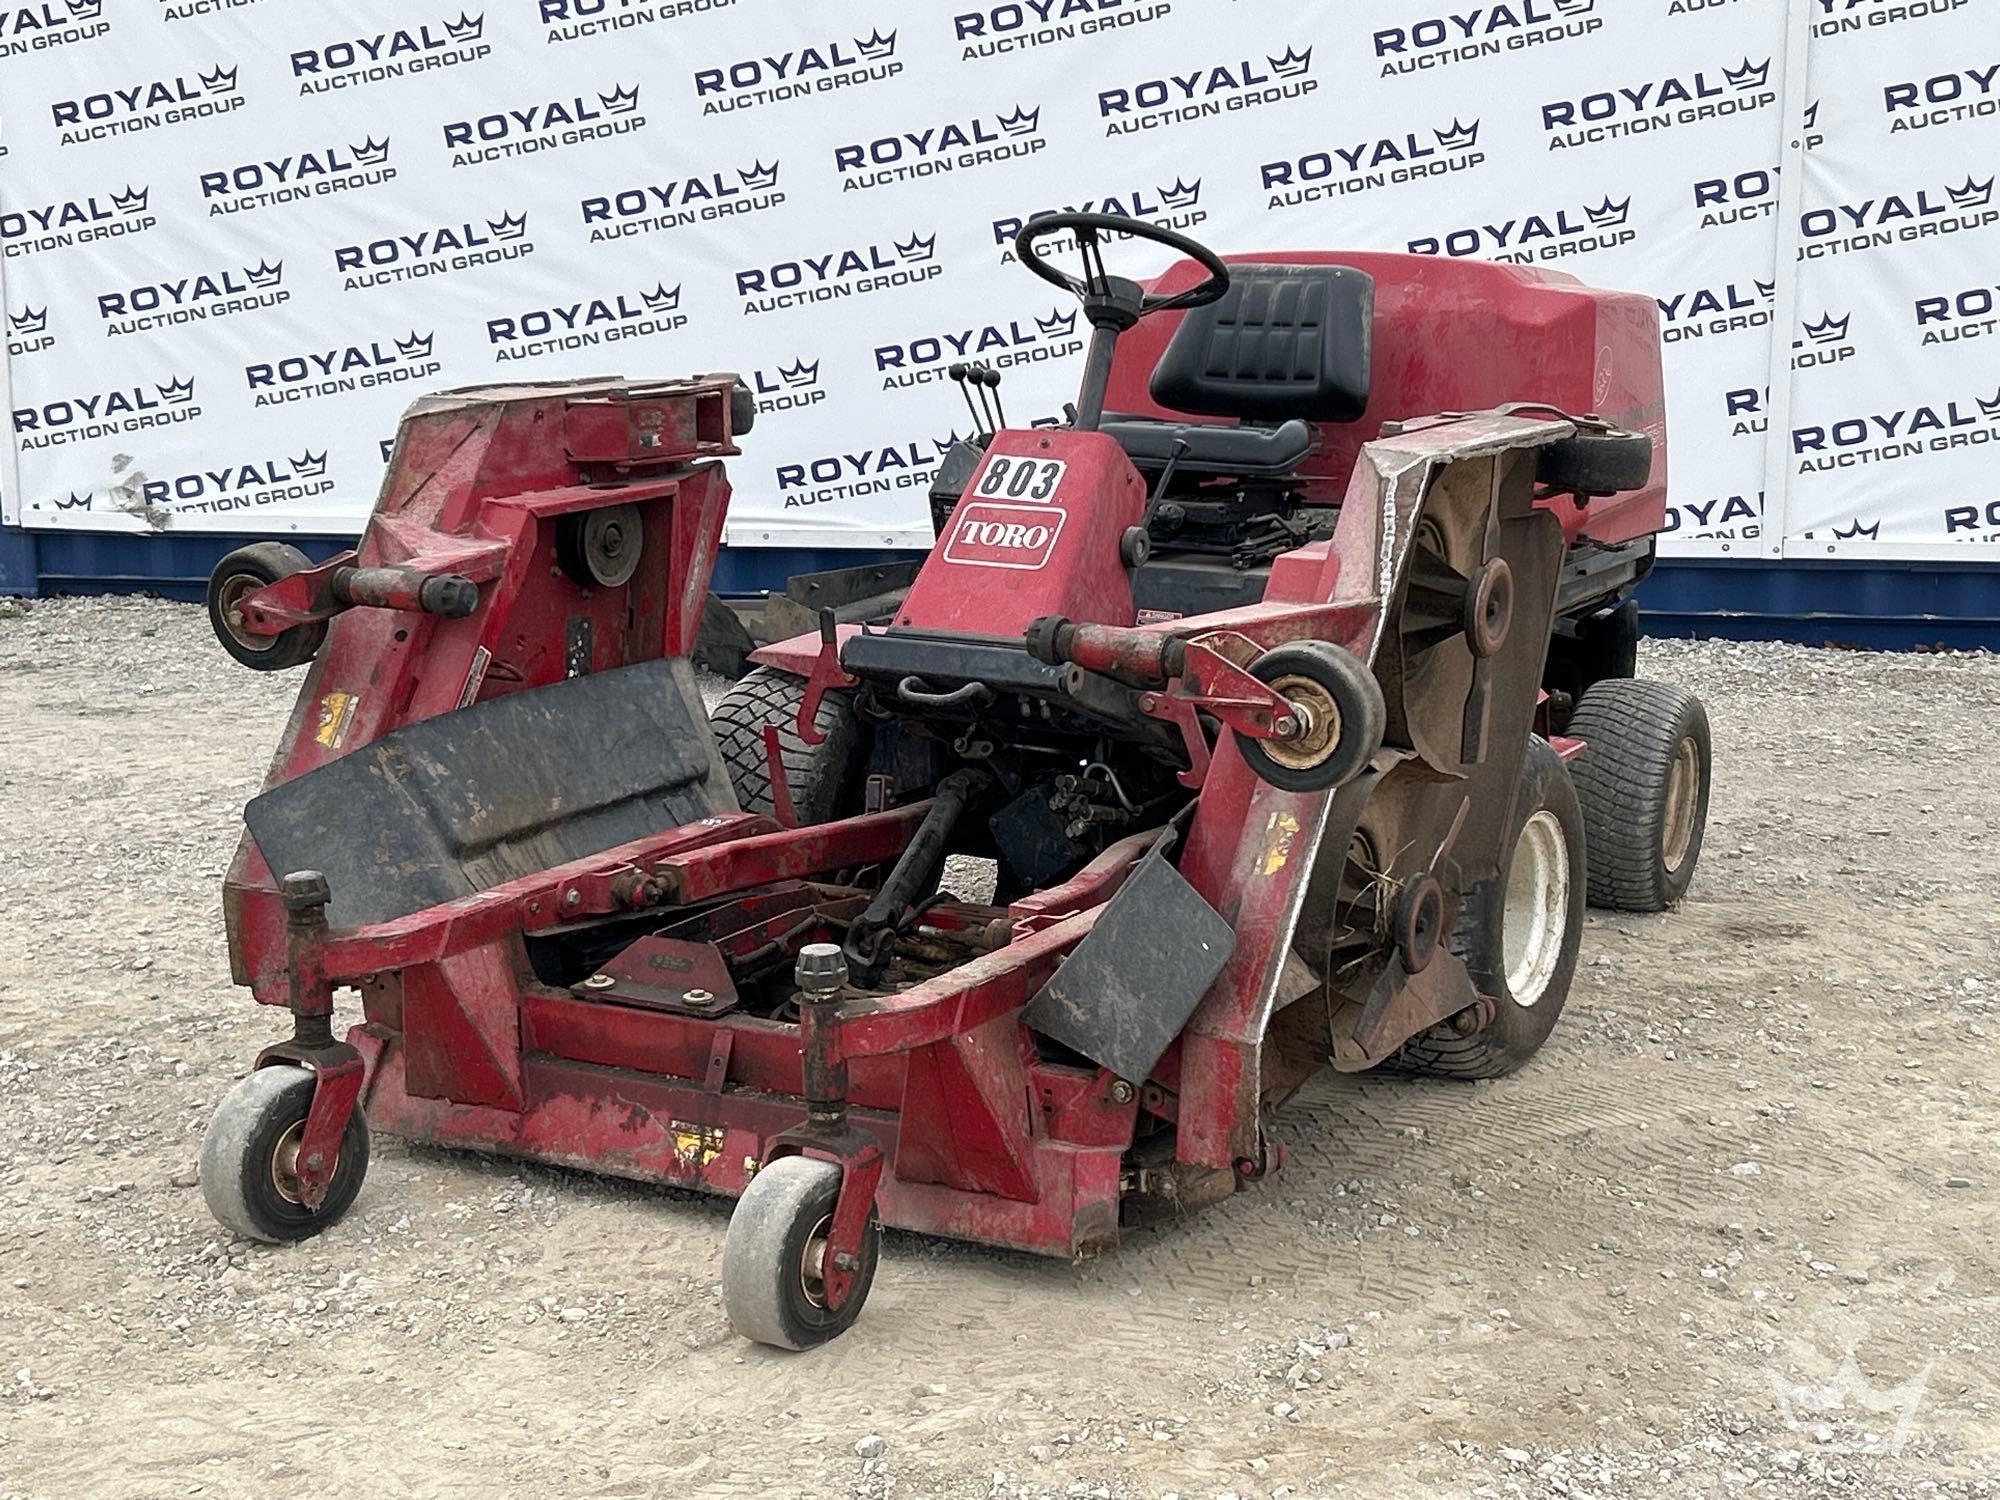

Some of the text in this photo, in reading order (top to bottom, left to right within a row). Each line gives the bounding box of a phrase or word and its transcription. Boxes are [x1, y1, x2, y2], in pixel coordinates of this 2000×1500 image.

[32, 22, 110, 49] GROUP
[548, 9, 654, 44] AUCTION
[962, 3, 1170, 61] AUCTION GROUP
[1373, 0, 1551, 57] ROYAL
[1381, 18, 1602, 78] AUCTION GROUP
[290, 26, 446, 77] ROYAL
[300, 45, 491, 96] AUCTION GROUP
[695, 43, 856, 96] ROYAL
[52, 78, 201, 127] ROYAL
[703, 62, 903, 116] AUCTION GROUP
[1098, 61, 1268, 117] ROYAL
[1106, 80, 1318, 137] AUCTION GROUP
[1542, 73, 1723, 130] ROYAL
[1884, 65, 2000, 112] ROY
[61, 97, 245, 146] AUCTION GROUP
[443, 98, 600, 148] ROYAL
[1549, 92, 1775, 151] AUCTION GROUP
[1890, 99, 2000, 134] AUCTIO
[453, 117, 646, 168] AUCTION GROUP
[835, 119, 998, 172] ROYAL
[843, 139, 1046, 192] AUCTION GROUP
[1261, 134, 1434, 189] ROYAL
[200, 149, 352, 198] ROYAL
[210, 168, 396, 217] AUCTION GROUP
[1268, 152, 1484, 210] AUCTION GROUP
[0, 198, 113, 238] OYAL
[581, 173, 739, 223] ROYAL
[590, 193, 785, 243] AUCTION GROUP
[1801, 190, 1945, 237] OYAL
[5, 217, 156, 257] CTION GROUP
[335, 224, 489, 272] ROYAL
[1540, 230, 1635, 260] GROUP
[1899, 211, 1999, 241] GROUP
[344, 243, 533, 291] AUCTION GROUP
[736, 246, 895, 296] ROYAL
[744, 265, 942, 315] AUCTION GROUP
[98, 272, 246, 318] ROYAL
[108, 291, 290, 337] AUCTION GROUP
[1657, 284, 1754, 321] YAL
[487, 296, 642, 344] ROYAL
[496, 315, 687, 362] AUCTION GROUP
[1922, 320, 1997, 346] AUCT
[8, 337, 55, 355] OUP
[246, 343, 396, 389] ROYAL
[874, 321, 1036, 371] ROYAL
[997, 341, 1082, 368] GROUP
[1791, 347, 1855, 370] OUP
[255, 362, 441, 408] AUCTION GROUP
[12, 388, 158, 433] ROYAL
[21, 407, 201, 451] AUCTION GROUP
[1792, 402, 1976, 454] ROYAL
[776, 443, 934, 490] ROYAL
[980, 457, 1060, 500] 803
[1799, 441, 1923, 474] AUCTION
[143, 461, 291, 505] ROYAL
[255, 480, 334, 504] GROUP
[784, 479, 890, 508] AUCTION
[960, 520, 1048, 550] TORO
